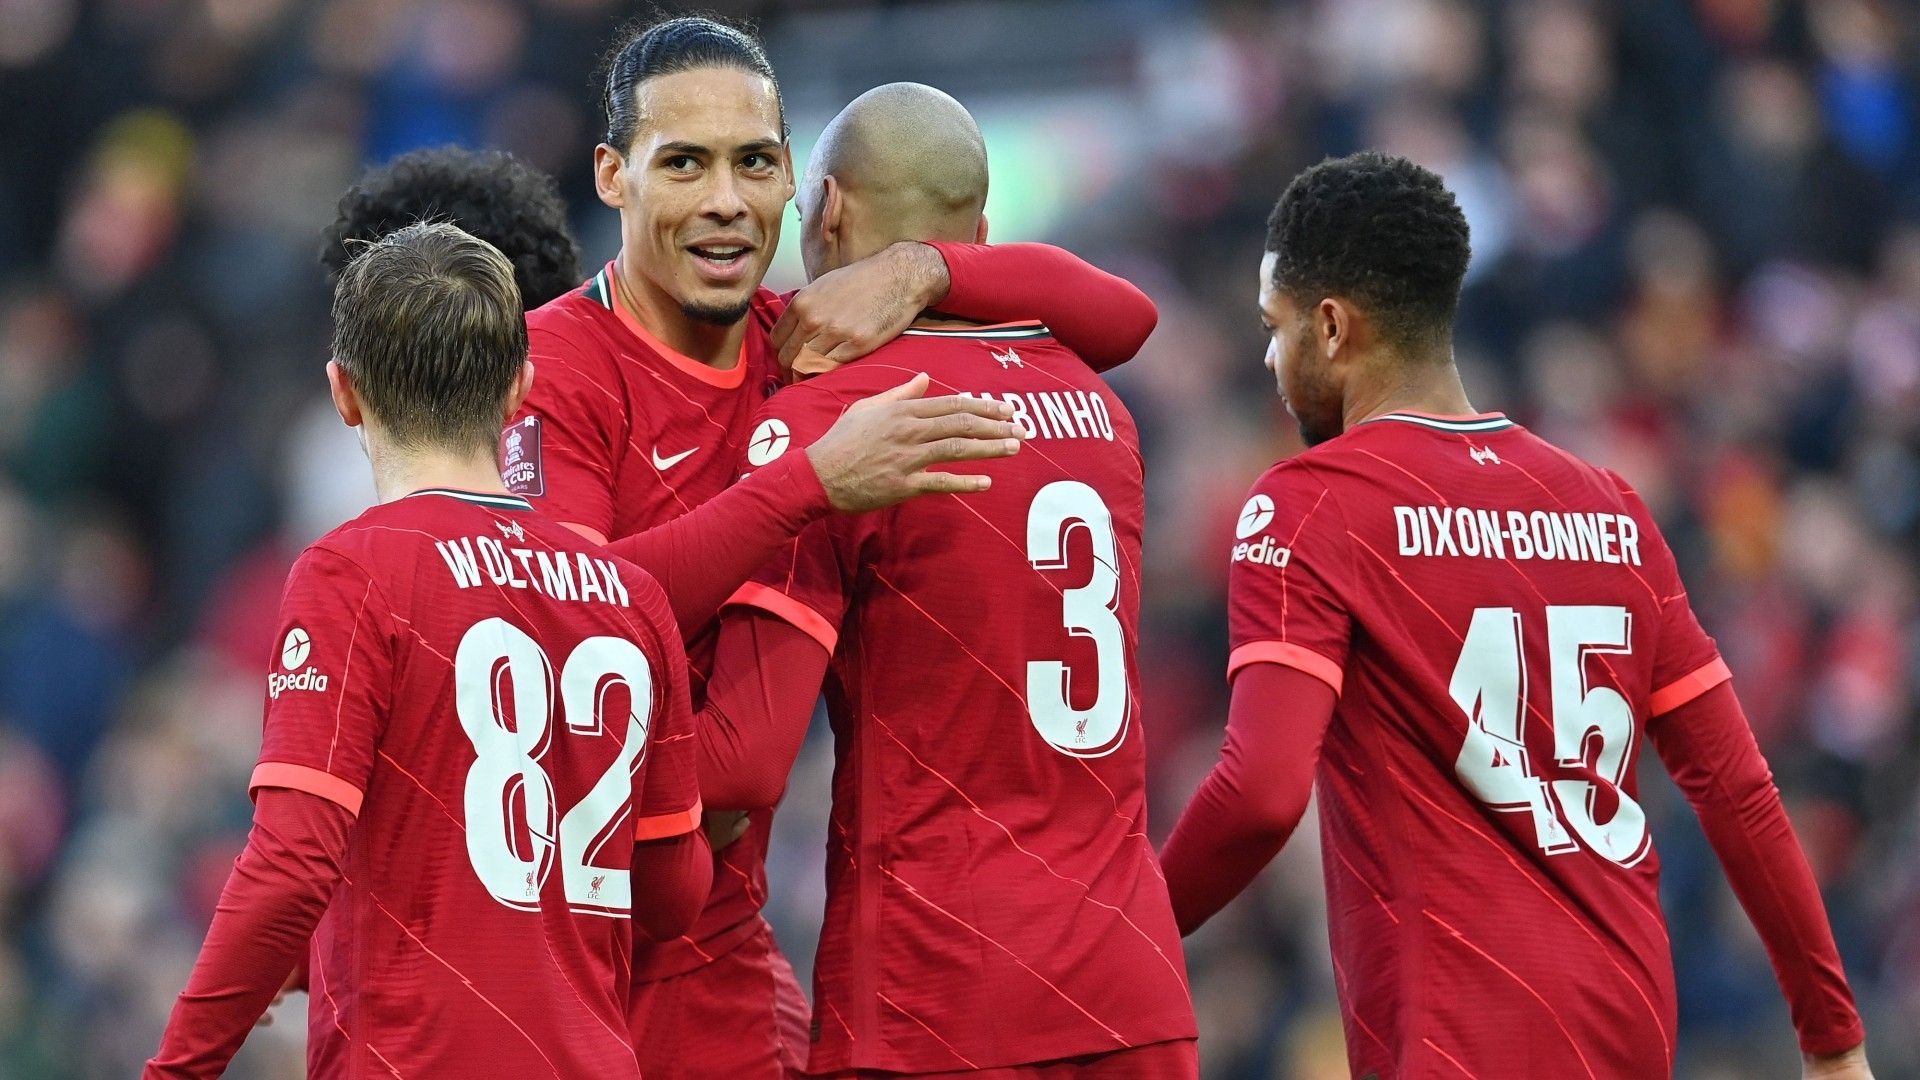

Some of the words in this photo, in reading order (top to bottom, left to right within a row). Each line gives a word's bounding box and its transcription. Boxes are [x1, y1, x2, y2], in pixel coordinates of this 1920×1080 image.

[959, 390, 1114, 442] BINHO
[509, 470, 535, 485] CUP
[435, 535, 630, 608] WOLTMAN
[1393, 505, 1642, 567] DIXON-BONNER
[1026, 480, 1131, 758] 3
[455, 617, 653, 918] 82
[1448, 605, 1652, 869] 45
